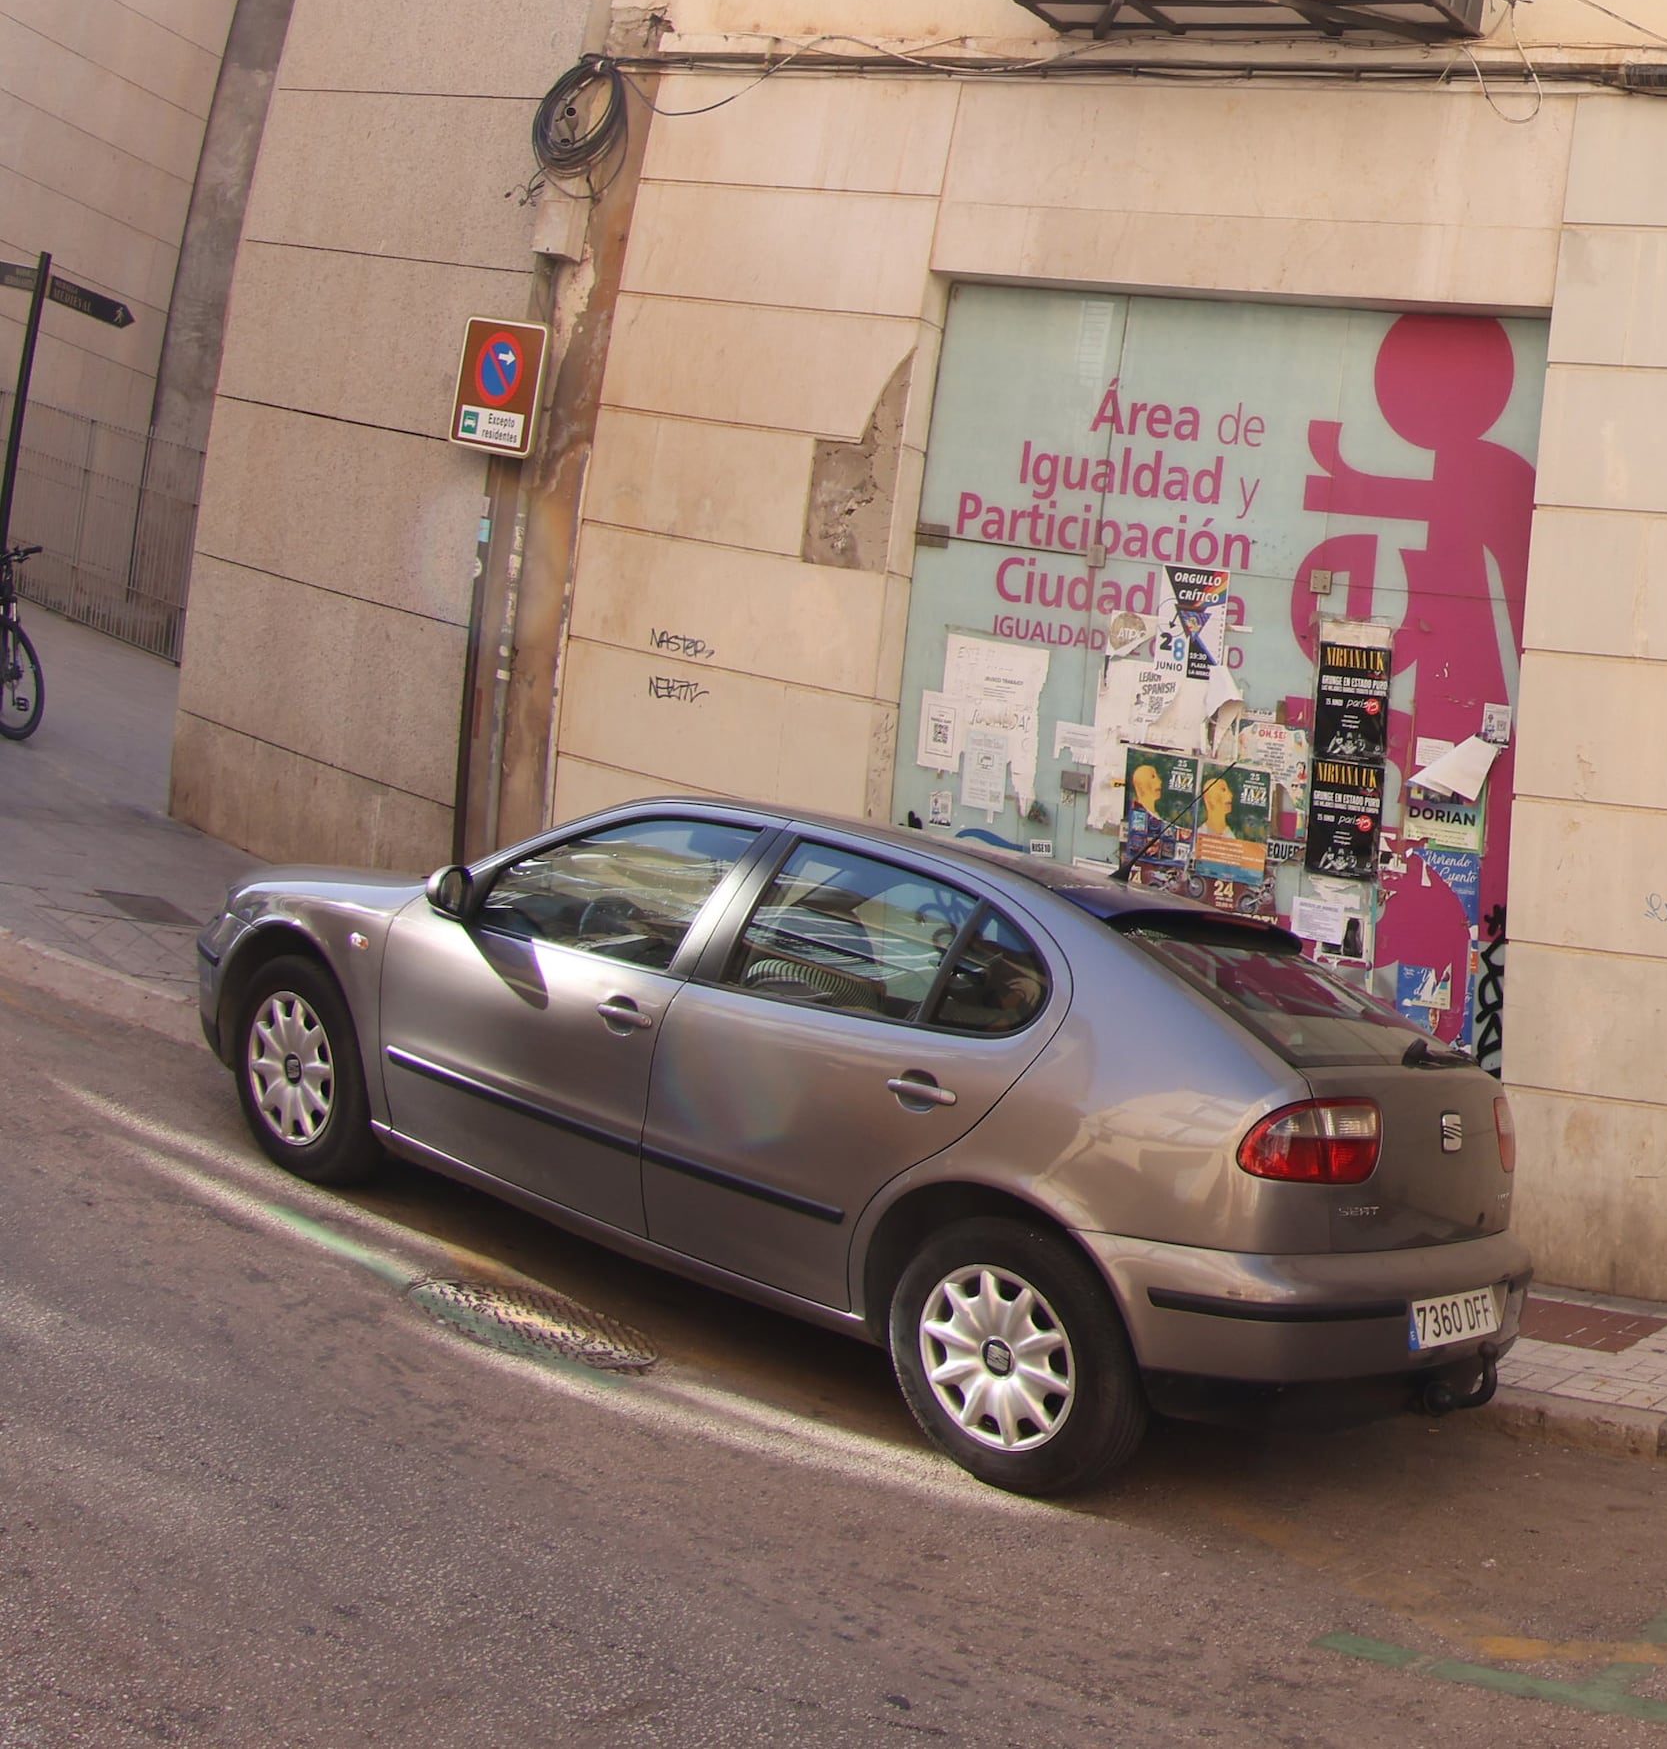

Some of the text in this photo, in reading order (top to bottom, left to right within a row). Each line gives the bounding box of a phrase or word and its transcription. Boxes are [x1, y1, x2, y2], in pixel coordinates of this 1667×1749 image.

[488, 412, 516, 428] Excepto
[1089, 377, 1265, 447] Área de
[481, 429, 518, 444] residentes
[1019, 439, 1260, 519] Igualdad y
[956, 491, 1251, 570] Participación
[1174, 572, 1222, 587] ORGULLO
[996, 557, 1246, 627] Ciudada
[1178, 589, 1220, 604] CRÍTICO
[1155, 661, 1184, 672] JUNIO
[1326, 647, 1385, 672] NIRVANA UK
[1142, 681, 1177, 696] SPANISH
[1250, 772, 1260, 782] 25
[1316, 762, 1377, 788] NIRVANA UK
[1343, 793, 1364, 806] ESTADO
[1408, 806, 1476, 827] DORIAN
[1213, 880, 1235, 898] 24
[1338, 1206, 1380, 1217] SEAT
[1415, 1293, 1491, 1341] 7360 DFF
